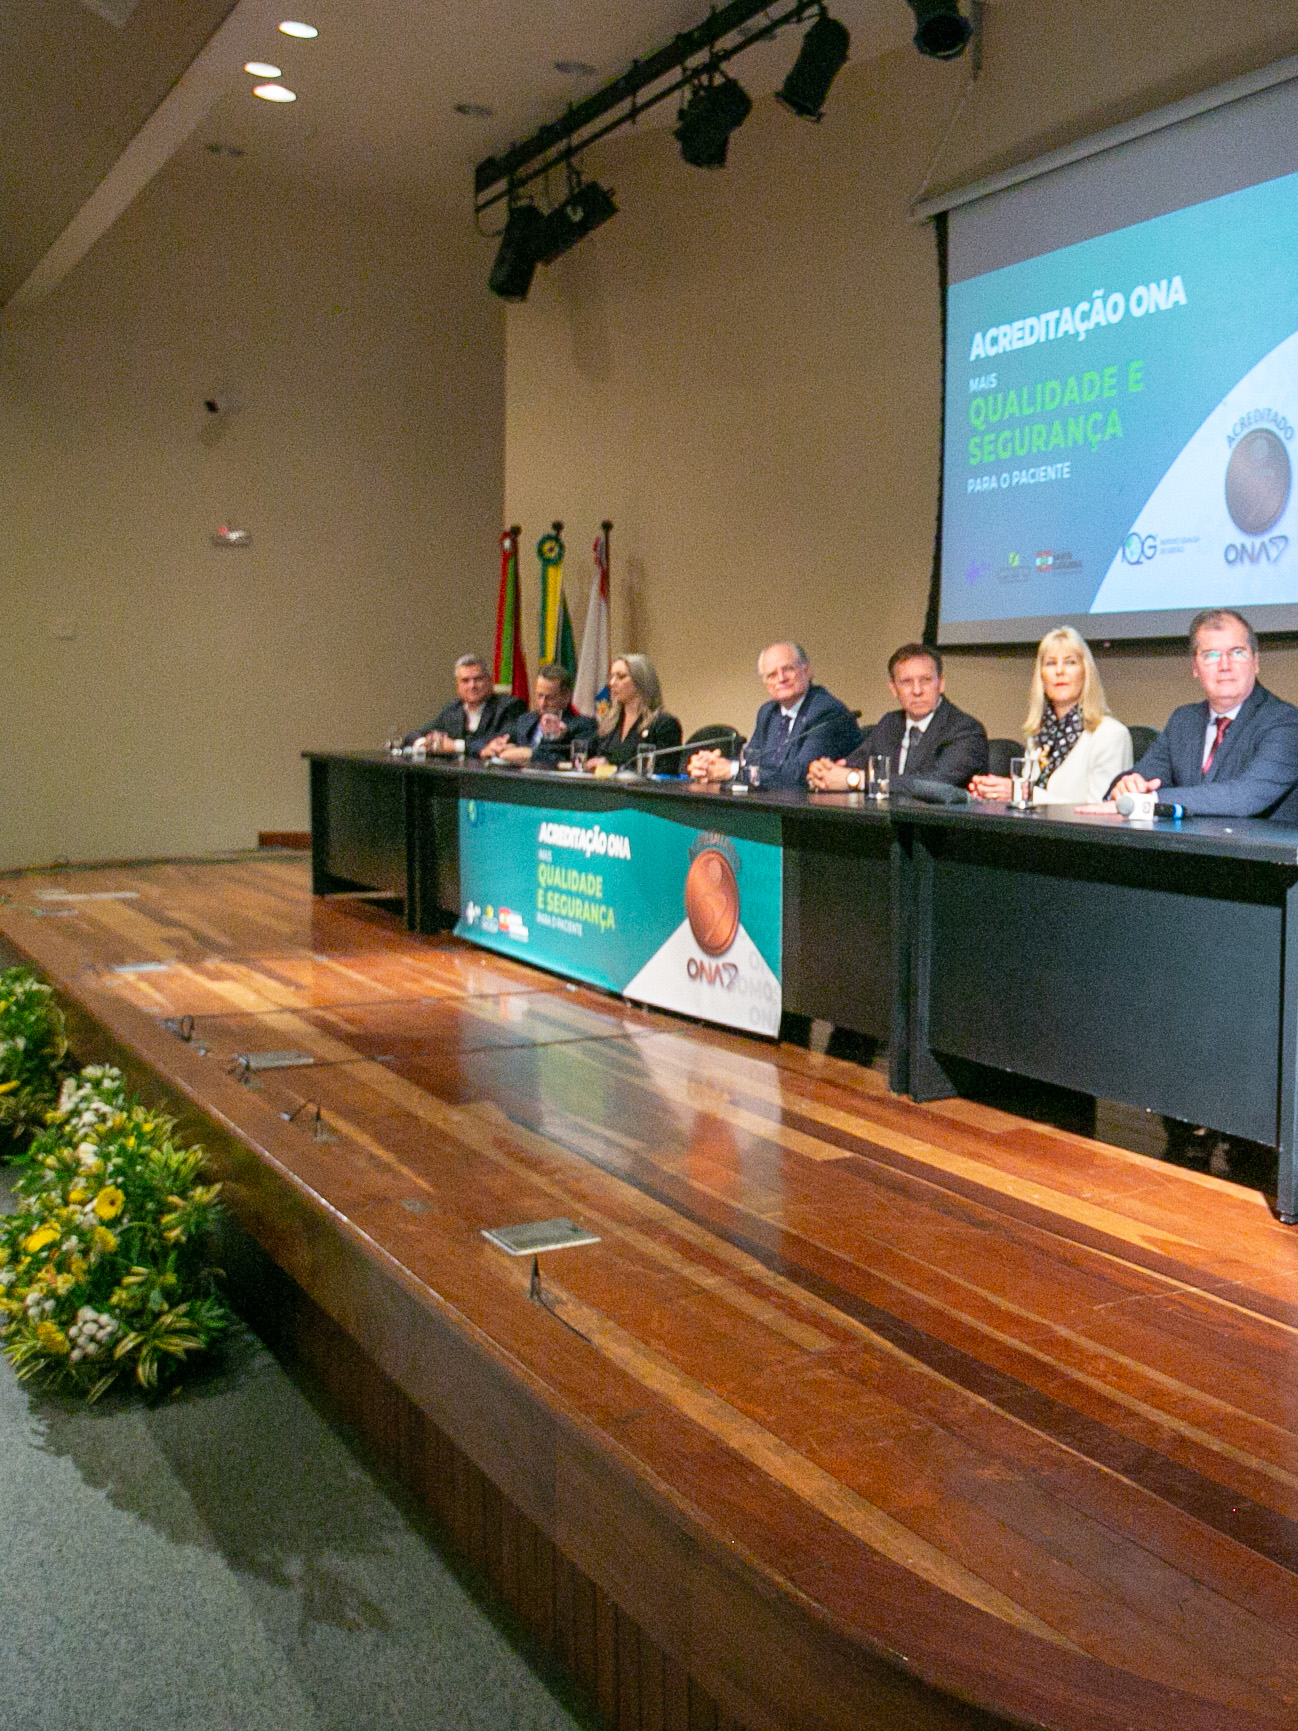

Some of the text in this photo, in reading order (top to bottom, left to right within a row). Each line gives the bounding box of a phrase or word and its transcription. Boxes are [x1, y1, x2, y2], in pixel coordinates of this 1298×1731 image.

[969, 275, 1188, 361] ACREDITAÇÃO ONA
[968, 372, 998, 393] MAIS
[968, 359, 1144, 431] QUALIDADE E
[968, 408, 1123, 467] SEGURANÇA
[1227, 408, 1295, 449] ACREDITADO
[967, 461, 1071, 493] PARA O PACIENTE
[607, 833, 632, 860] ONA
[537, 862, 603, 899] QUALIDADE
[536, 888, 544, 910] E
[546, 890, 615, 933] SEGURANÇA
